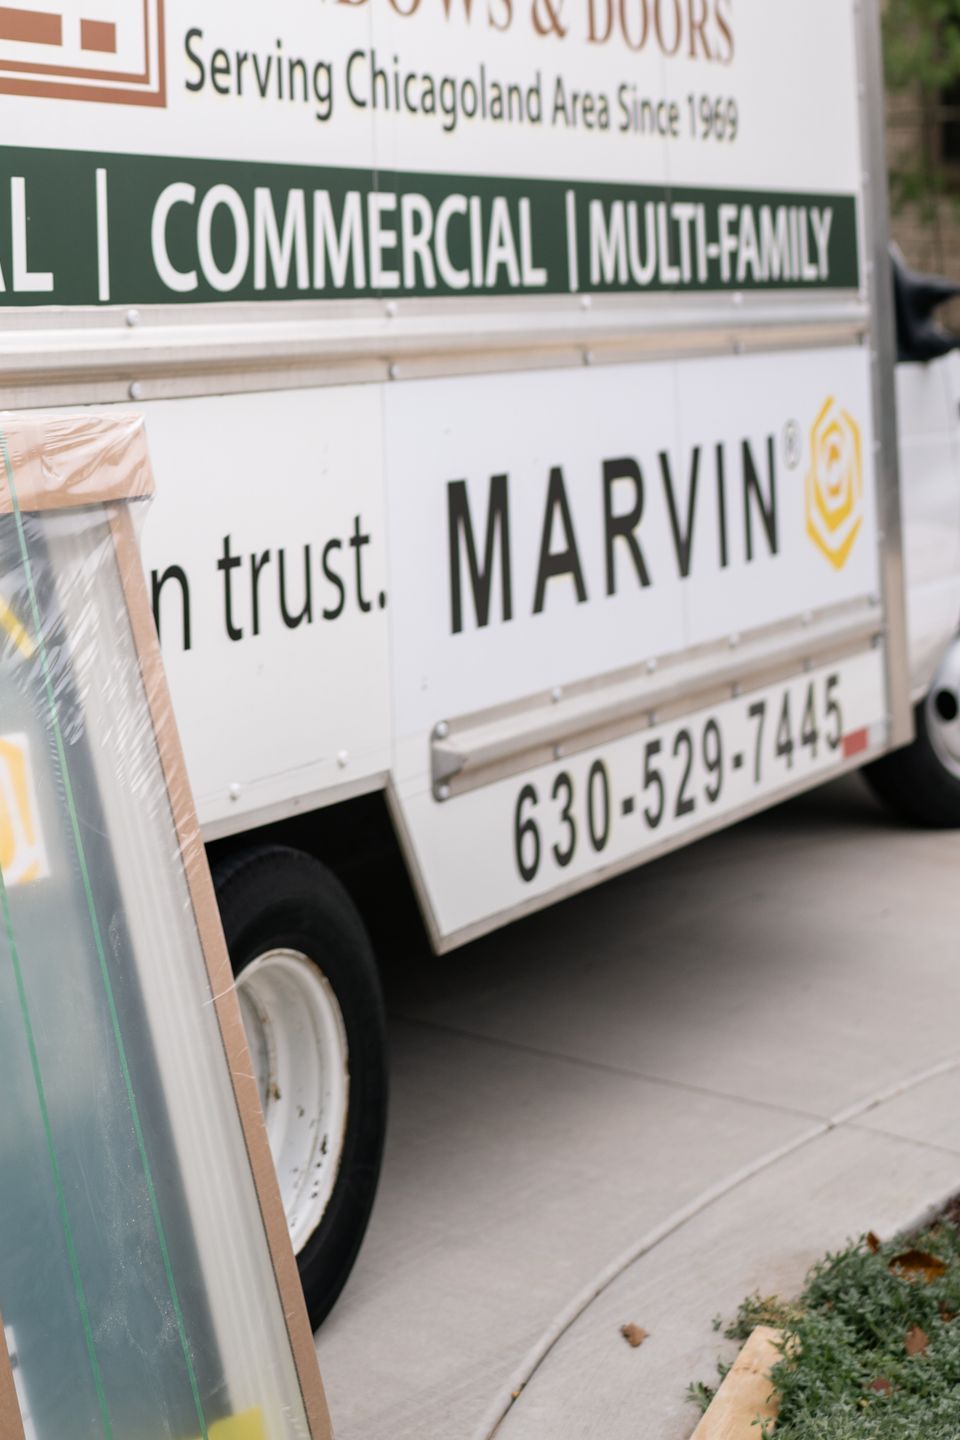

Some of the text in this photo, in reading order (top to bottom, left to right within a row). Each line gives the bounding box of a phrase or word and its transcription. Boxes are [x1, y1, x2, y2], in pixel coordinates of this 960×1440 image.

[183, 27, 739, 142] Serving Chicagoland Area Since 1969
[151, 181, 548, 292] COMMERCIAL
[589, 199, 833, 285] MULTI-FAMILY
[216, 513, 388, 643] trust.
[513, 671, 843, 882] 630-529-7445
